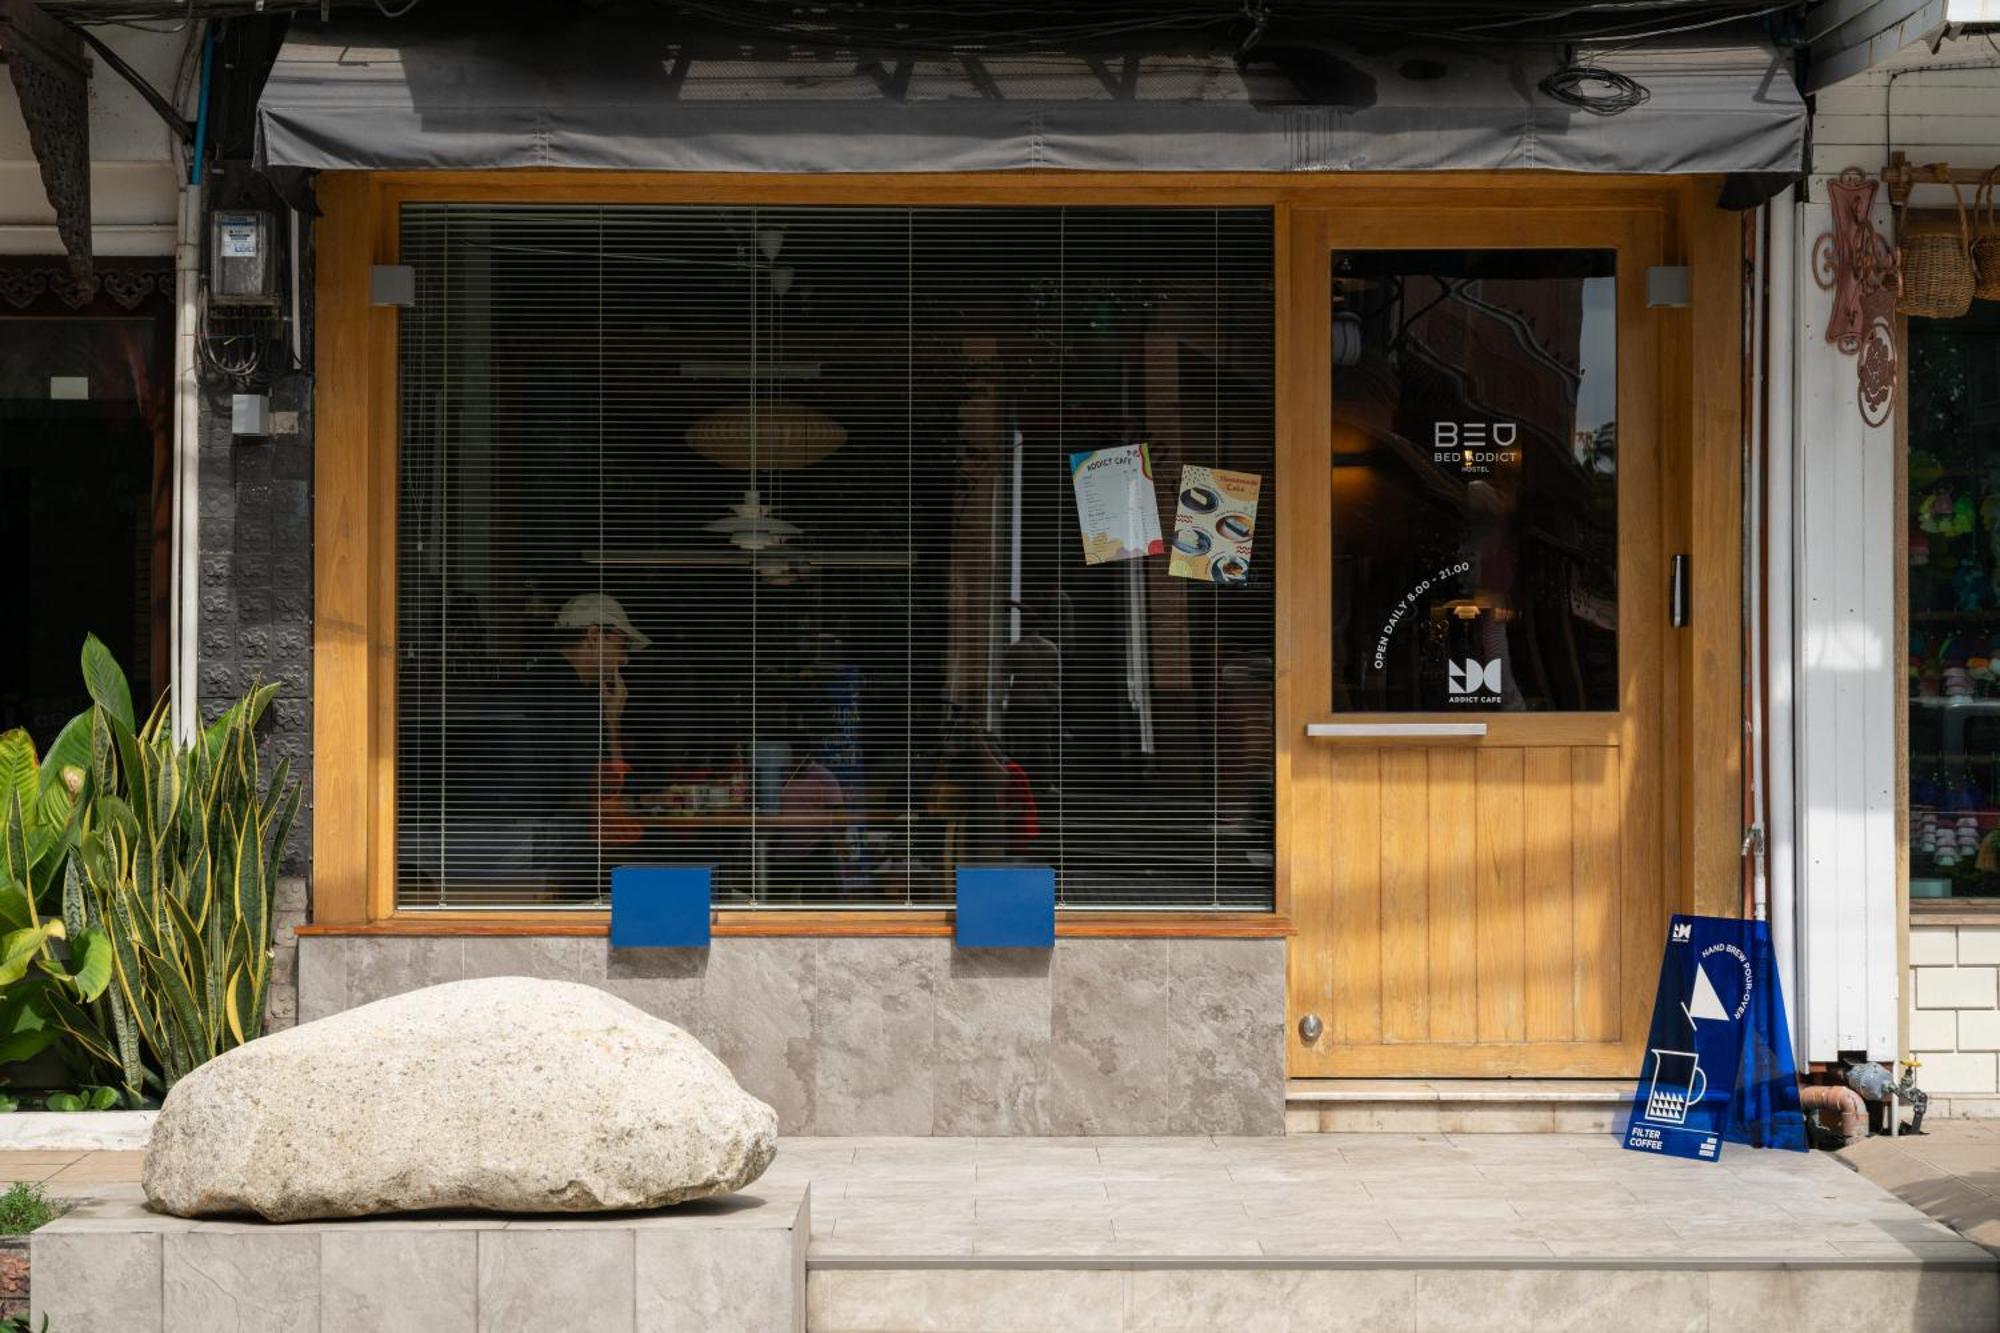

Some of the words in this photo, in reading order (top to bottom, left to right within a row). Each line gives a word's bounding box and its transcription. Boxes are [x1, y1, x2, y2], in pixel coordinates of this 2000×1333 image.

[1434, 421, 1517, 447] BED
[1434, 452, 1461, 462] BED
[1374, 636, 1389, 669] OPEN
[1384, 600, 1408, 634] DAILY
[1407, 580, 1430, 602] 8.00
[1439, 562, 1469, 580] 21.00
[1702, 943, 1725, 958] HAND
[1726, 944, 1748, 962] BREW
[1733, 962, 1753, 1020] POUR-OVER
[1631, 1127, 1661, 1140] FILTER
[1629, 1137, 1664, 1150] COFFEE
